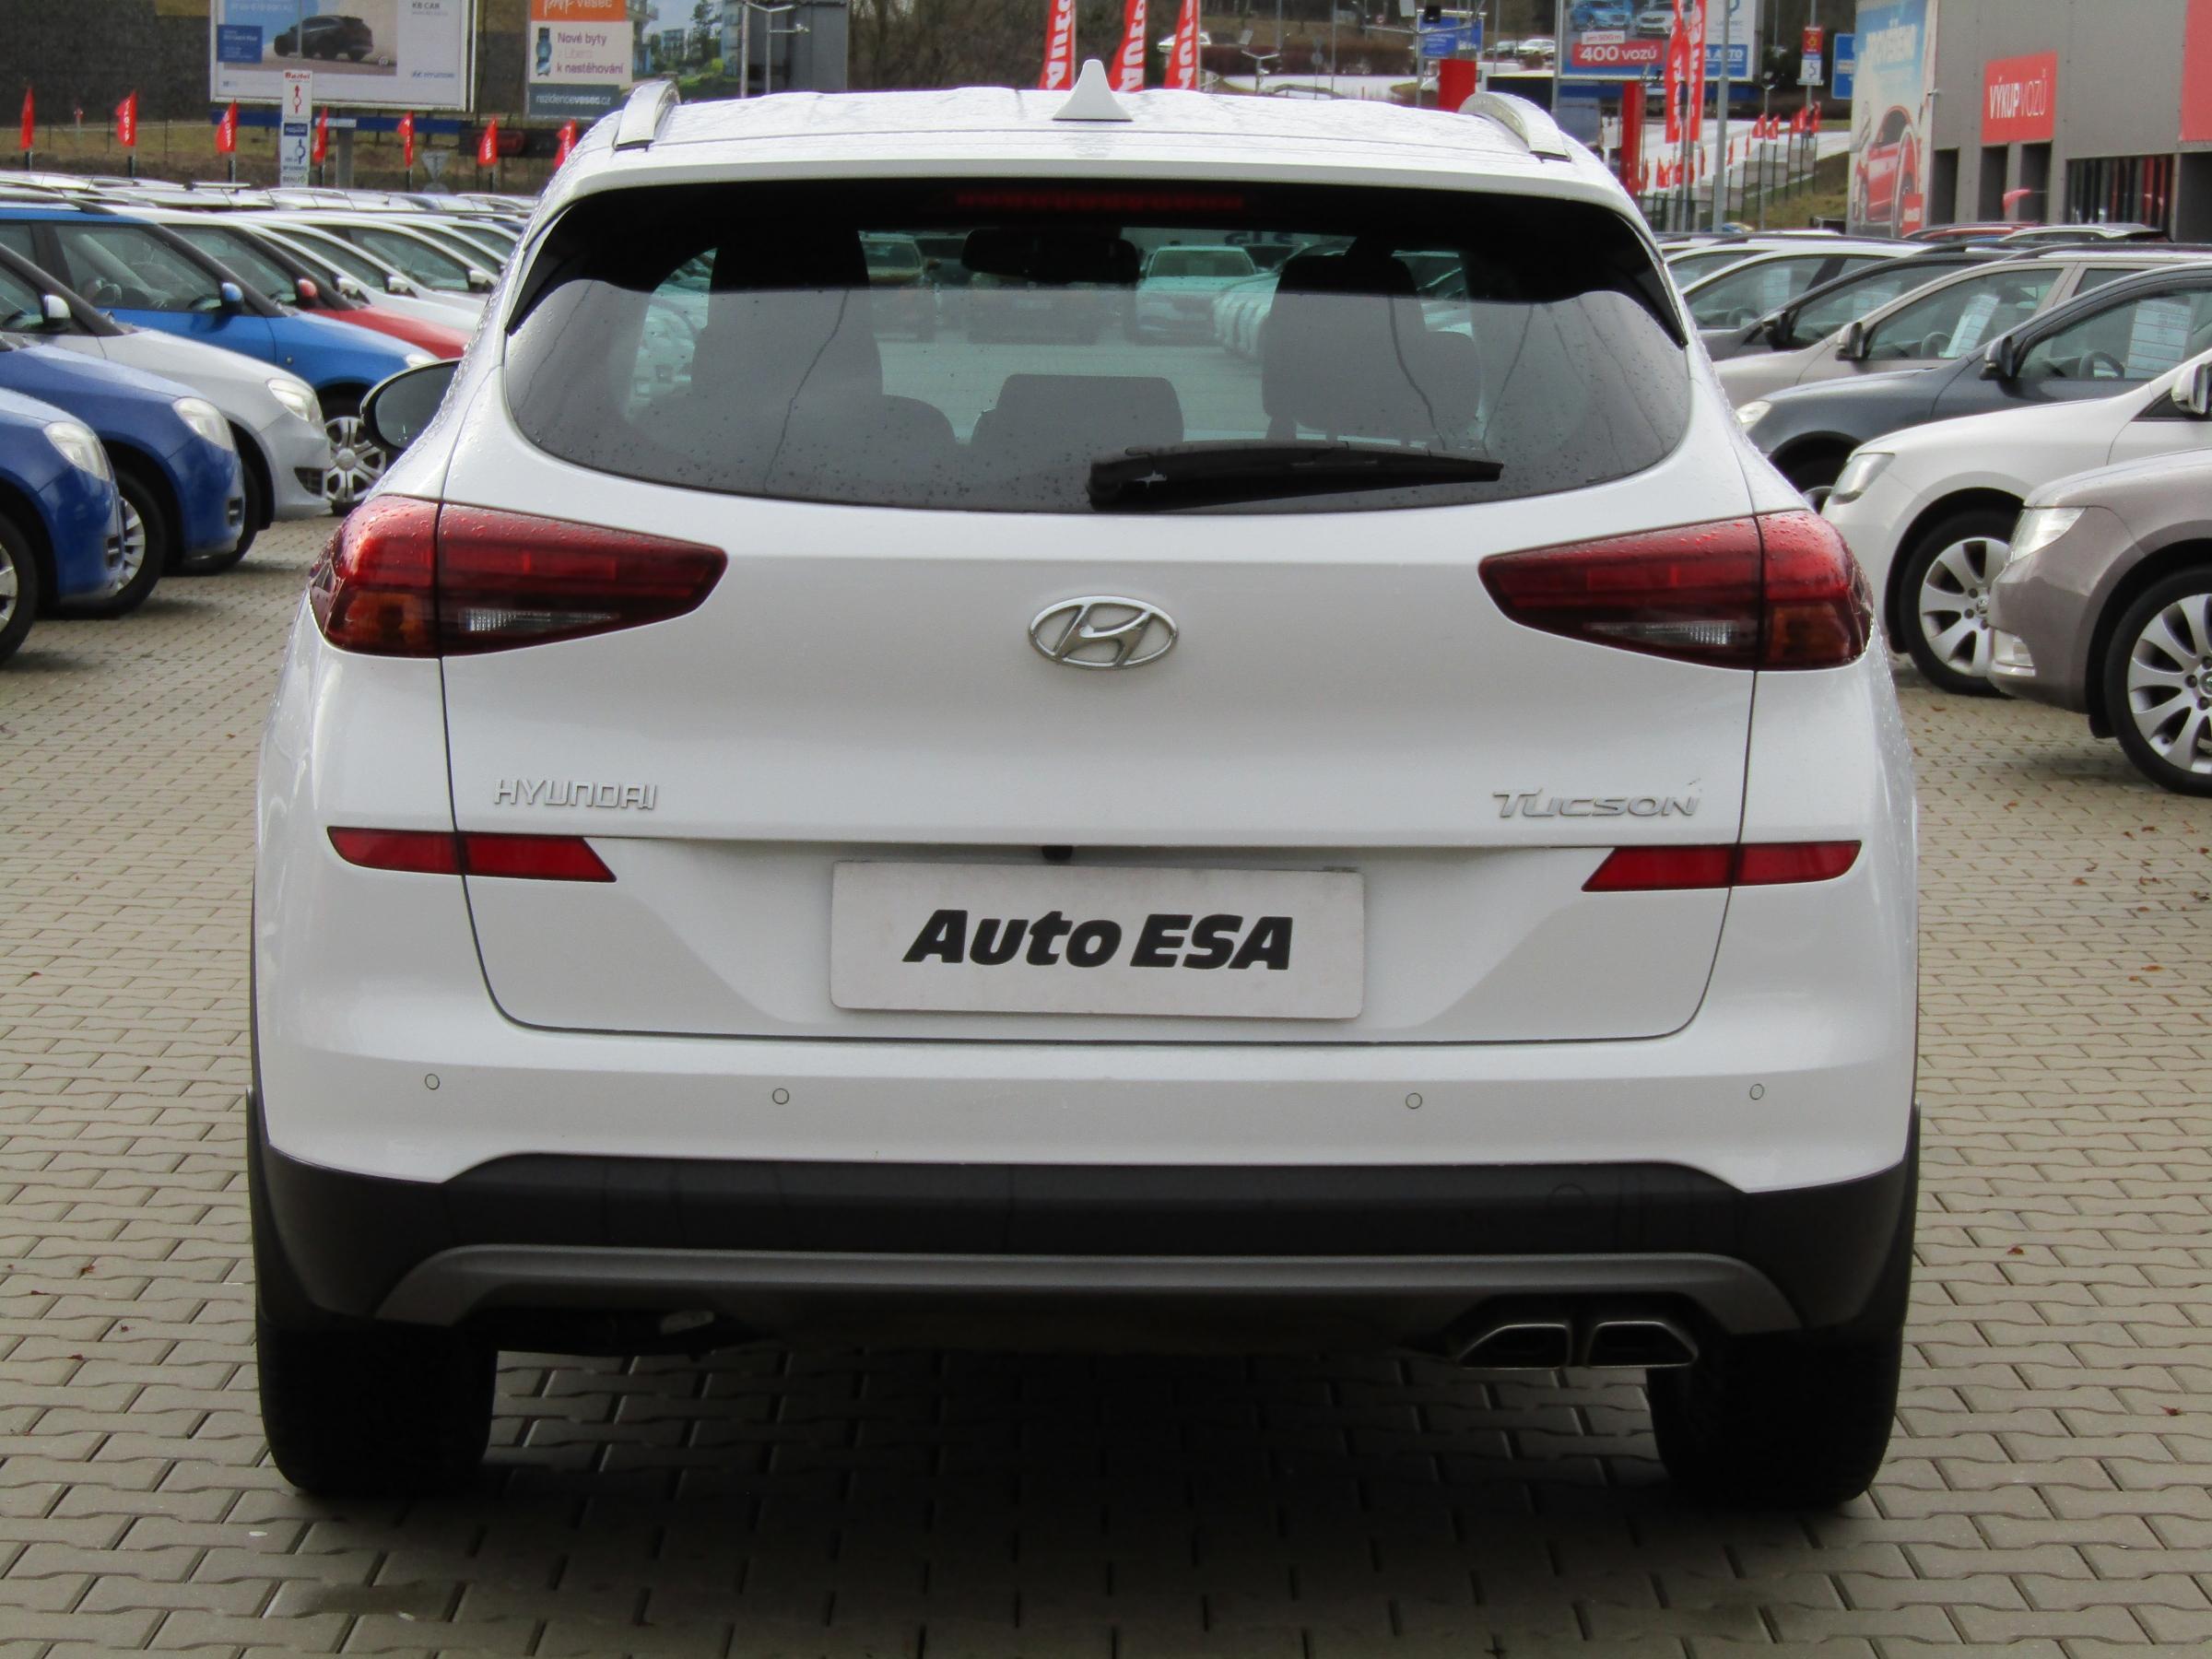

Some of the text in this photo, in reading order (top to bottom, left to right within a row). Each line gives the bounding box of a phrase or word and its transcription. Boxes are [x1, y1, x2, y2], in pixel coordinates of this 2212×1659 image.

[558, 32, 607, 47] Nové byty
[1580, 46, 1619, 62] 400
[494, 779, 657, 811] HYUNDAI
[1492, 787, 1701, 818] TUCSON
[902, 909, 1293, 971] Auto ESA
